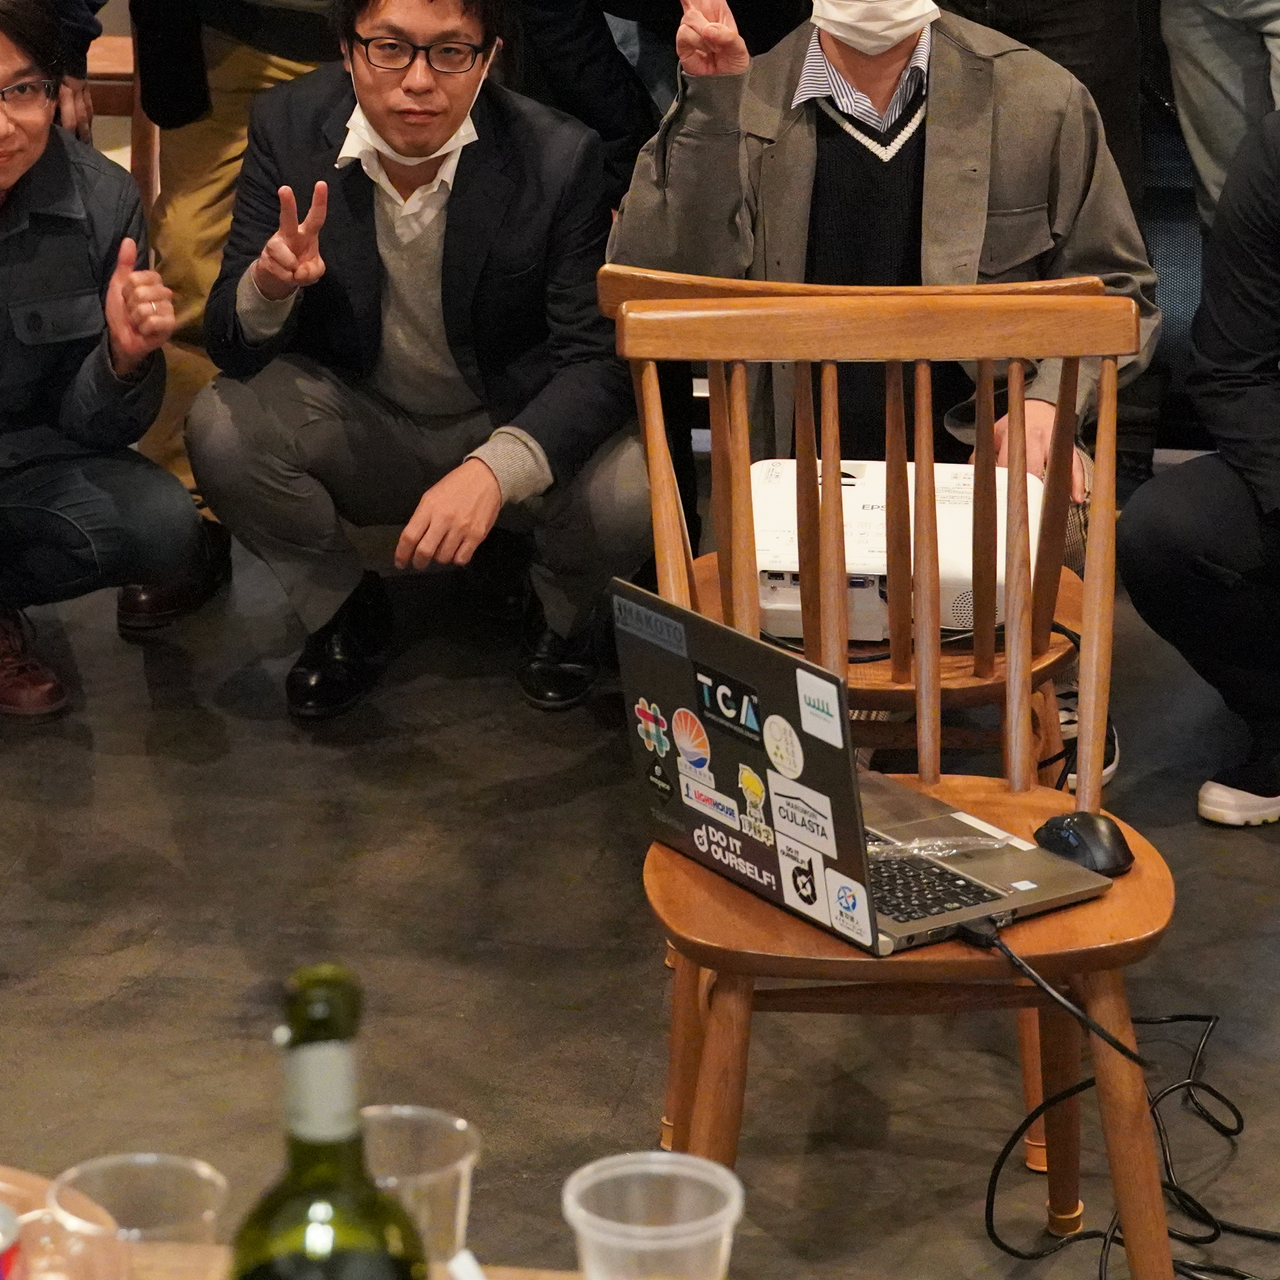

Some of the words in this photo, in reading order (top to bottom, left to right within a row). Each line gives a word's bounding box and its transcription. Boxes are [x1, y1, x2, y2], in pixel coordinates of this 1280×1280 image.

[693, 790, 736, 819] LIGHTHOUSE
[778, 806, 828, 840] CULASTA
[707, 825, 727, 847] DO
[729, 836, 741, 855] IT
[710, 844, 777, 891] OURSELF!
